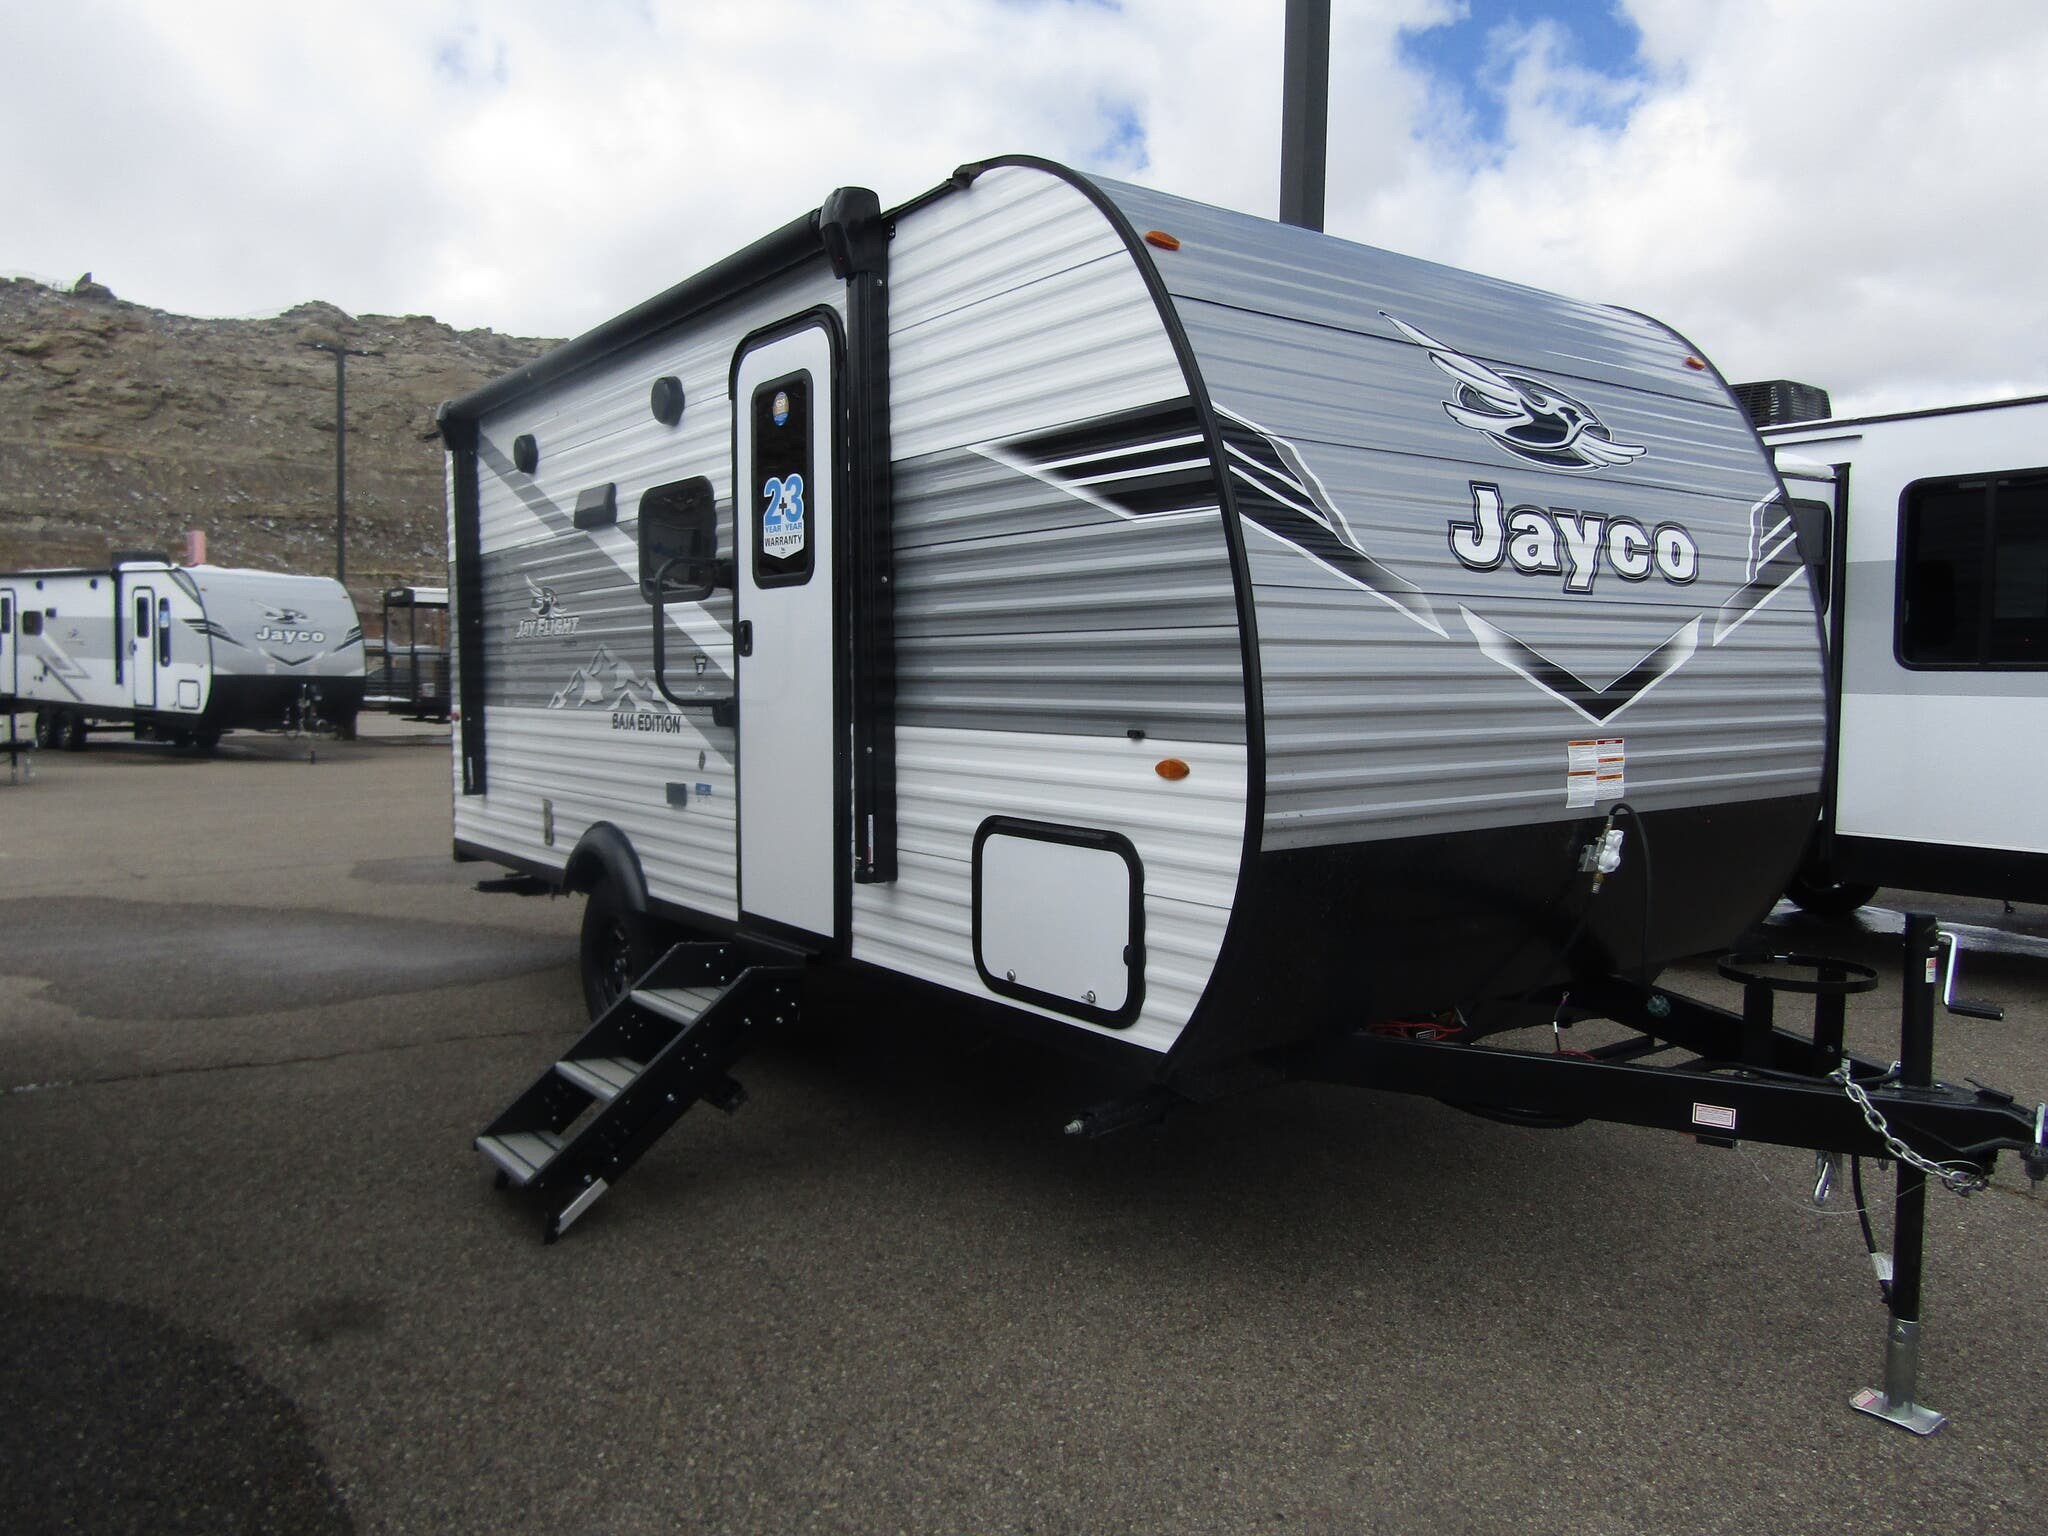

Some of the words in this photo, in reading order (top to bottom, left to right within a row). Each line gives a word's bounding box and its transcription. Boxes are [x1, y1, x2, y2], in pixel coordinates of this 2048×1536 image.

[765, 525, 781, 534] YEAR
[785, 522, 802, 532] YEAR
[1448, 480, 1699, 595] Jayco
[764, 535, 803, 547] WARRANTY
[256, 625, 327, 645] Jayco
[514, 619, 537, 639] JAY
[536, 616, 579, 637] FLIGHT
[612, 713, 635, 730] BAJA
[638, 714, 681, 734] EDITION
